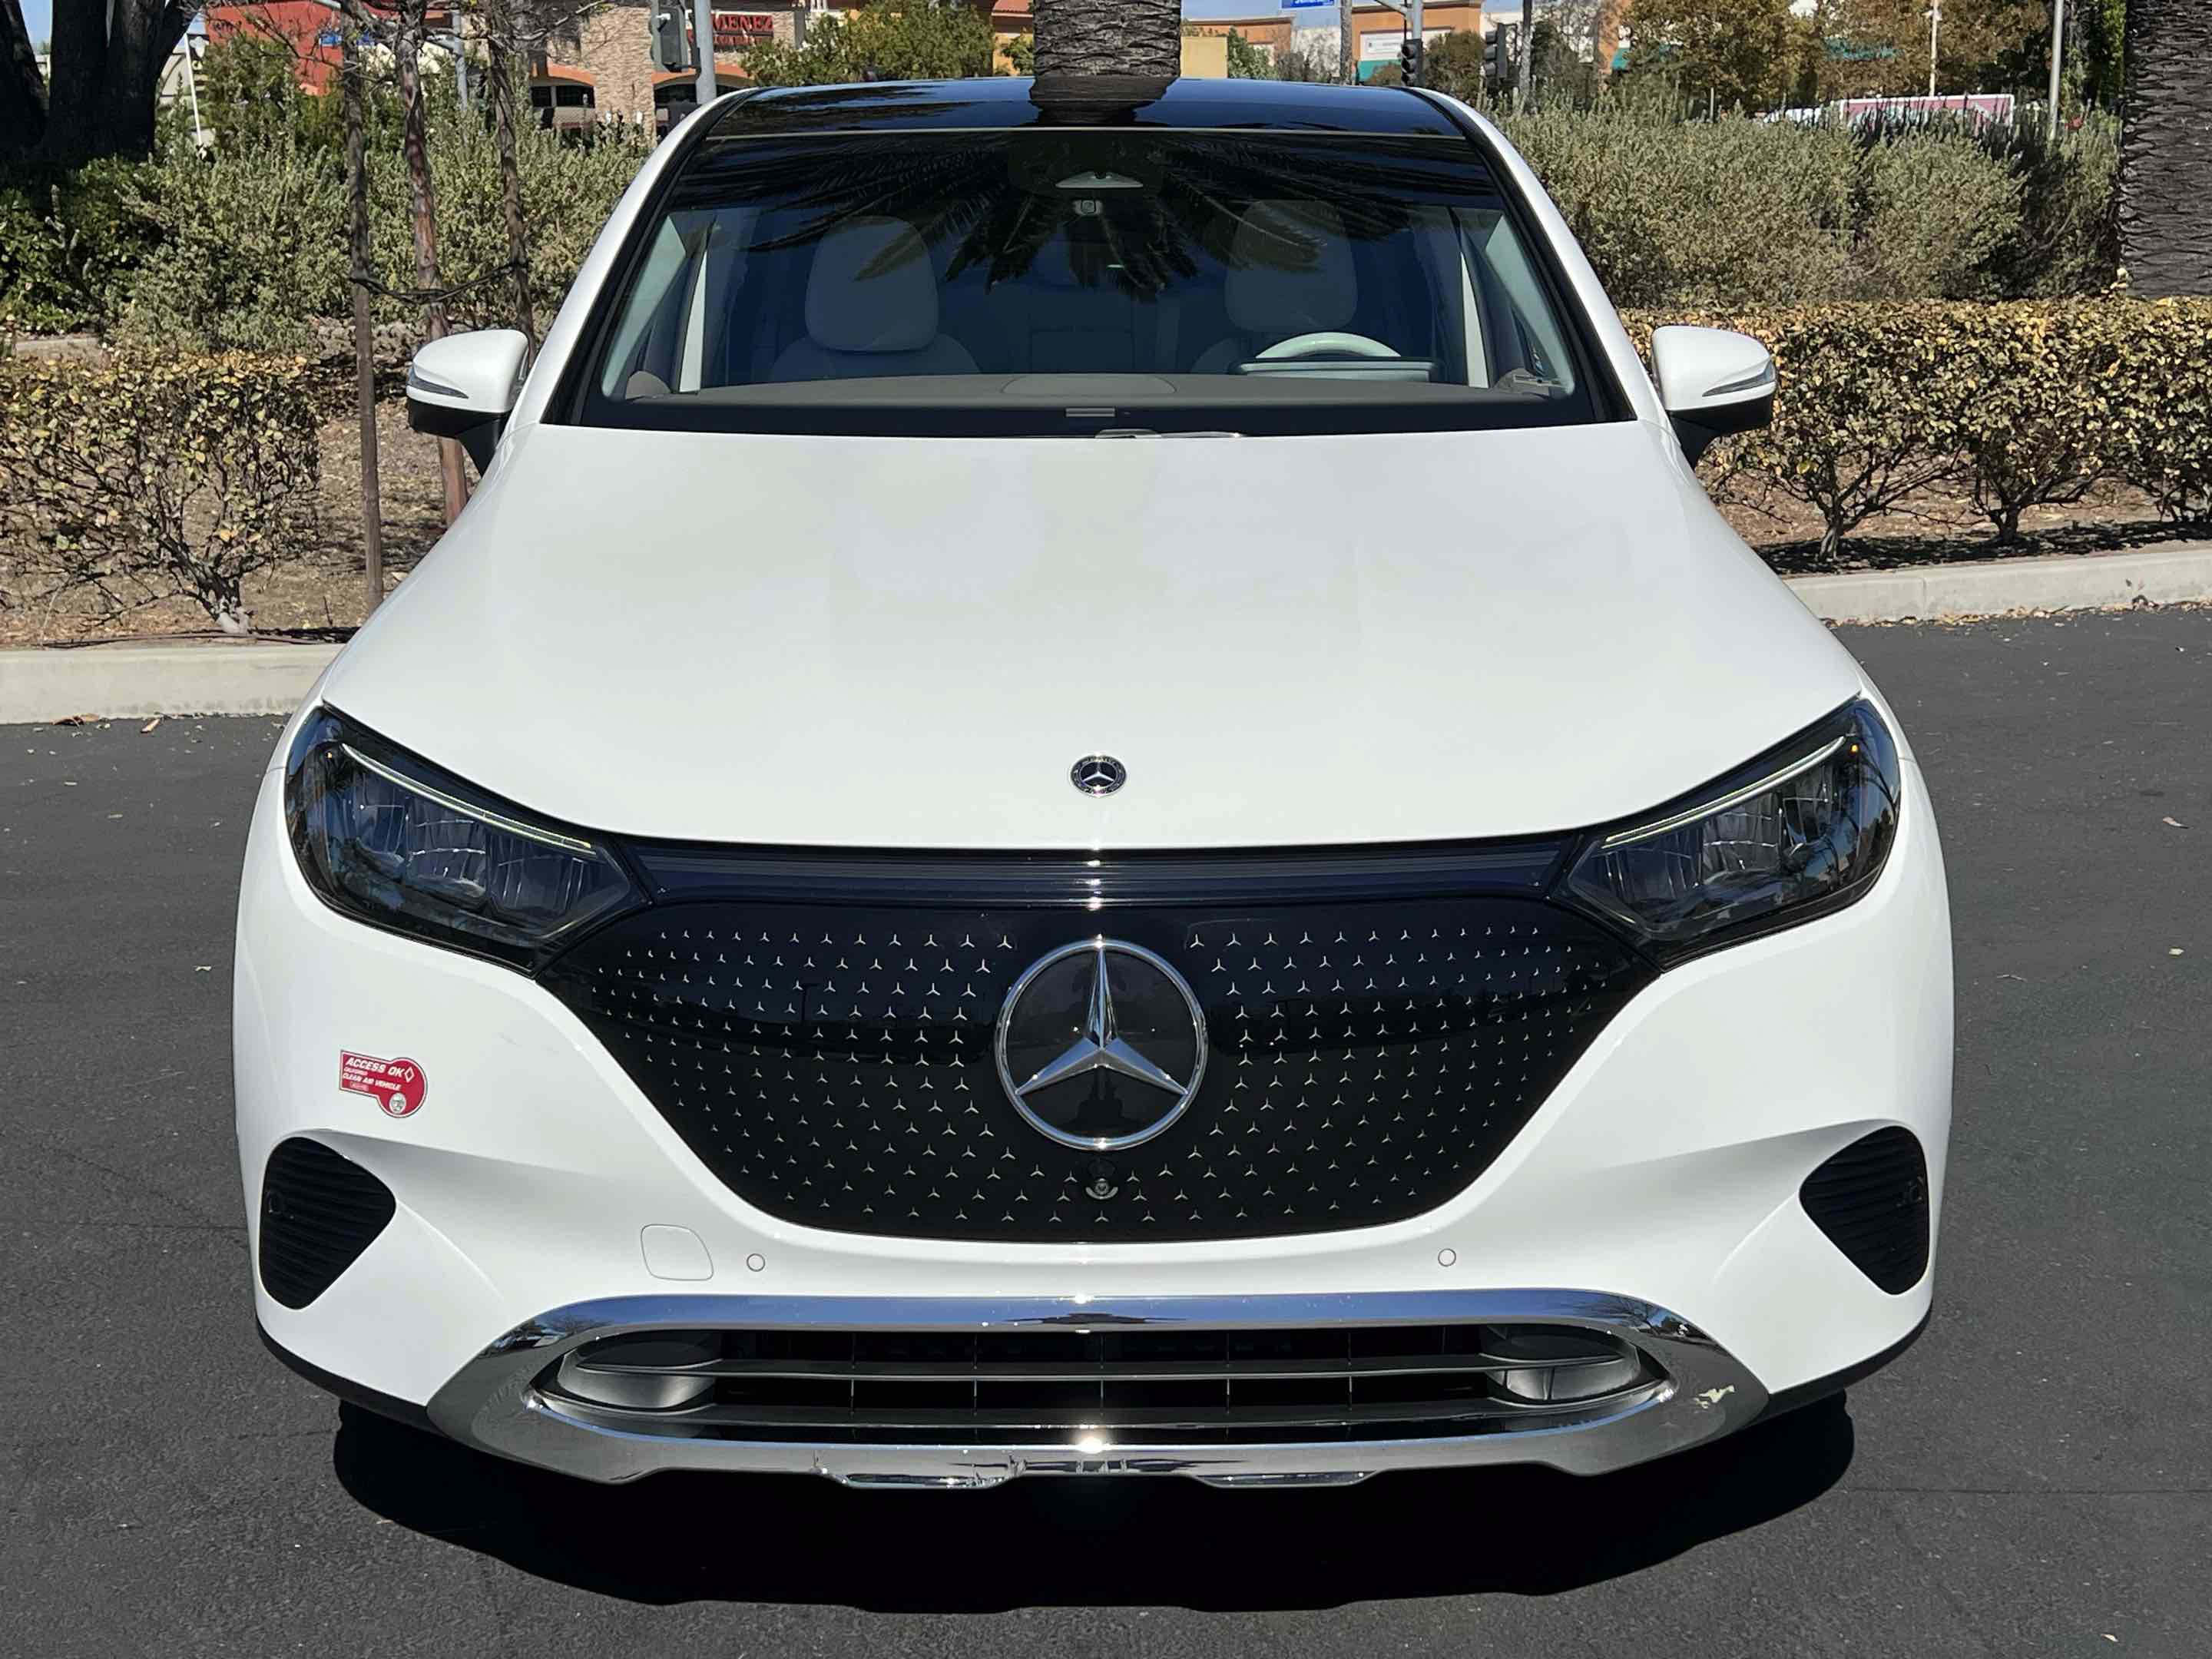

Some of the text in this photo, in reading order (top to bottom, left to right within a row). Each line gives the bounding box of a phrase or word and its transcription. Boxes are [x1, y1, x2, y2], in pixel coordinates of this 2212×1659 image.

[710, 15, 773, 31] MENEZ
[346, 1058, 386, 1073] ACCESS
[388, 1067, 405, 1077] OK
